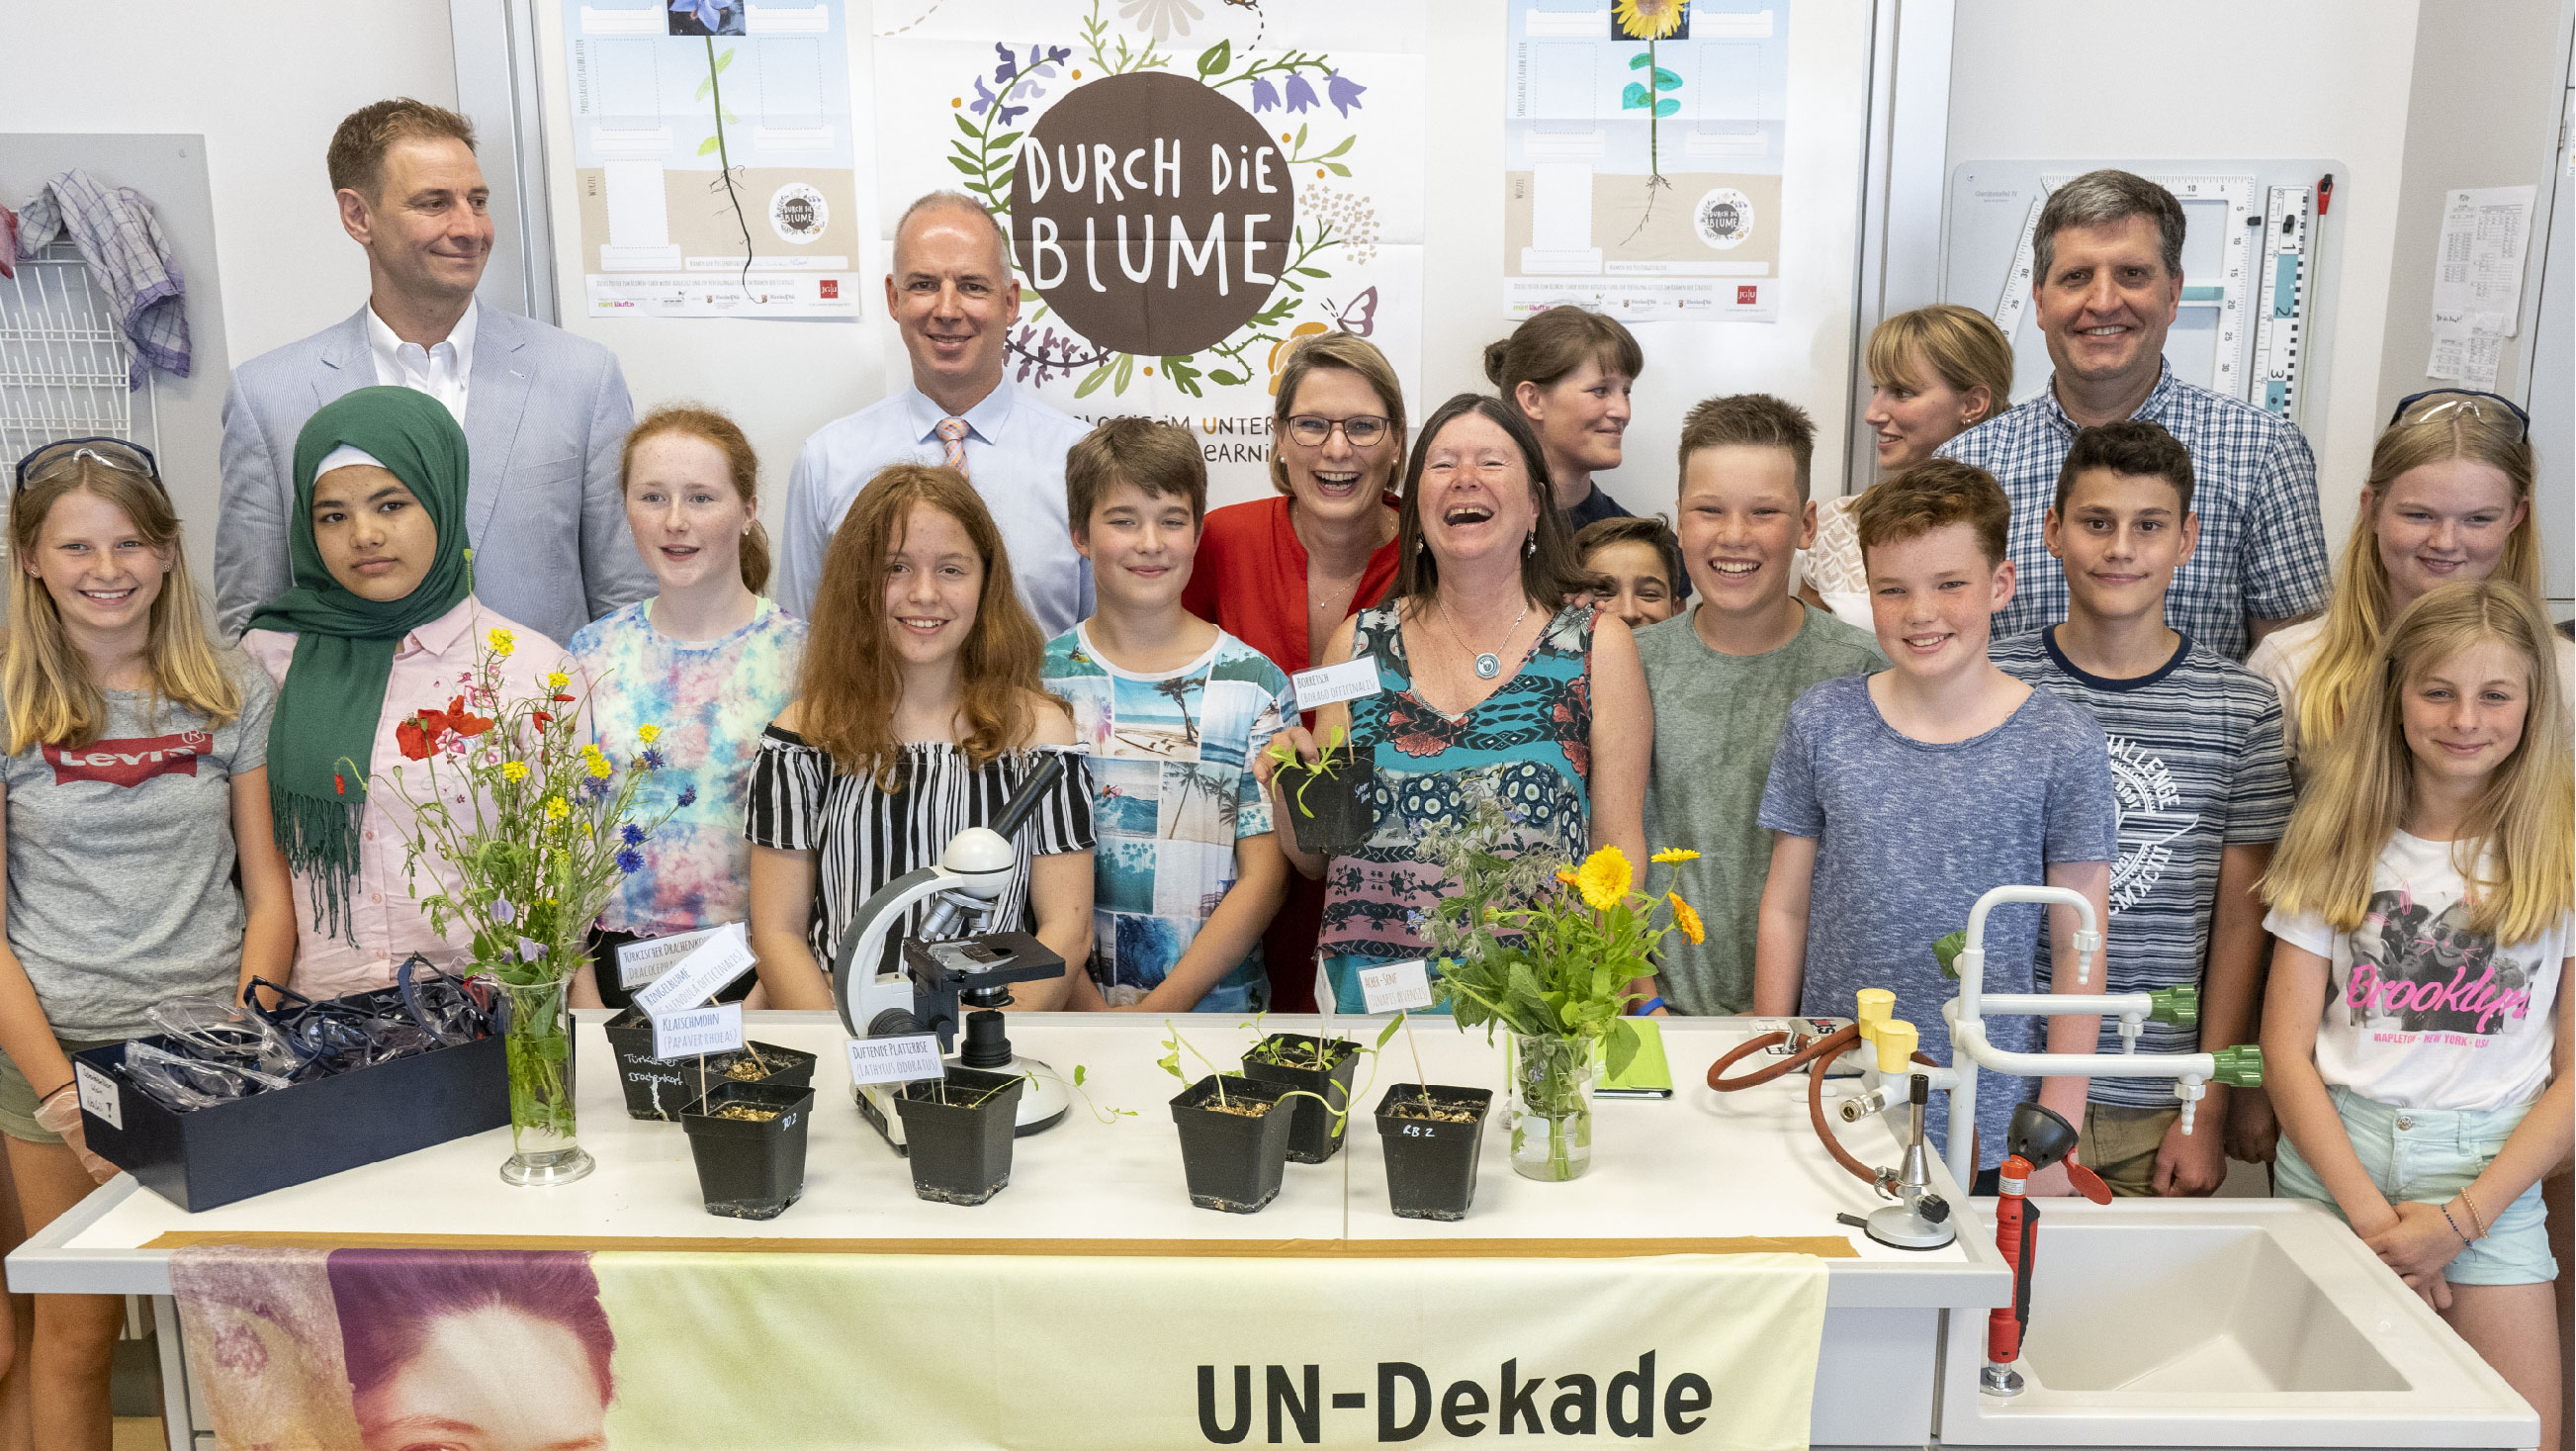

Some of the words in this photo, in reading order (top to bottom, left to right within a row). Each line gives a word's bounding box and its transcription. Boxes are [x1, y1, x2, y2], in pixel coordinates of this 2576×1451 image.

[1024, 136, 1181, 204] DURCH
[784, 214, 814, 224] BLUME
[1709, 218, 1739, 228] BLUME
[1032, 212, 1276, 296] BLUME
[2020, 268, 2030, 279] 30
[2230, 268, 2239, 278] 15
[2010, 299, 2019, 310] 25
[2227, 300, 2236, 310] 20
[2275, 307, 2291, 317] 2
[2224, 331, 2233, 341] 25
[2221, 363, 2230, 373] 30
[2270, 369, 2284, 379] 3
[1296, 674, 1330, 689] BORRETSCH
[645, 967, 692, 1007] RINGELBLUME
[2346, 963, 2532, 1034] Brooklyn
[2423, 1033, 2443, 1043] NEW
[2443, 1034, 2468, 1046] YORK
[1198, 1348, 1713, 1444] UN-Dekade
